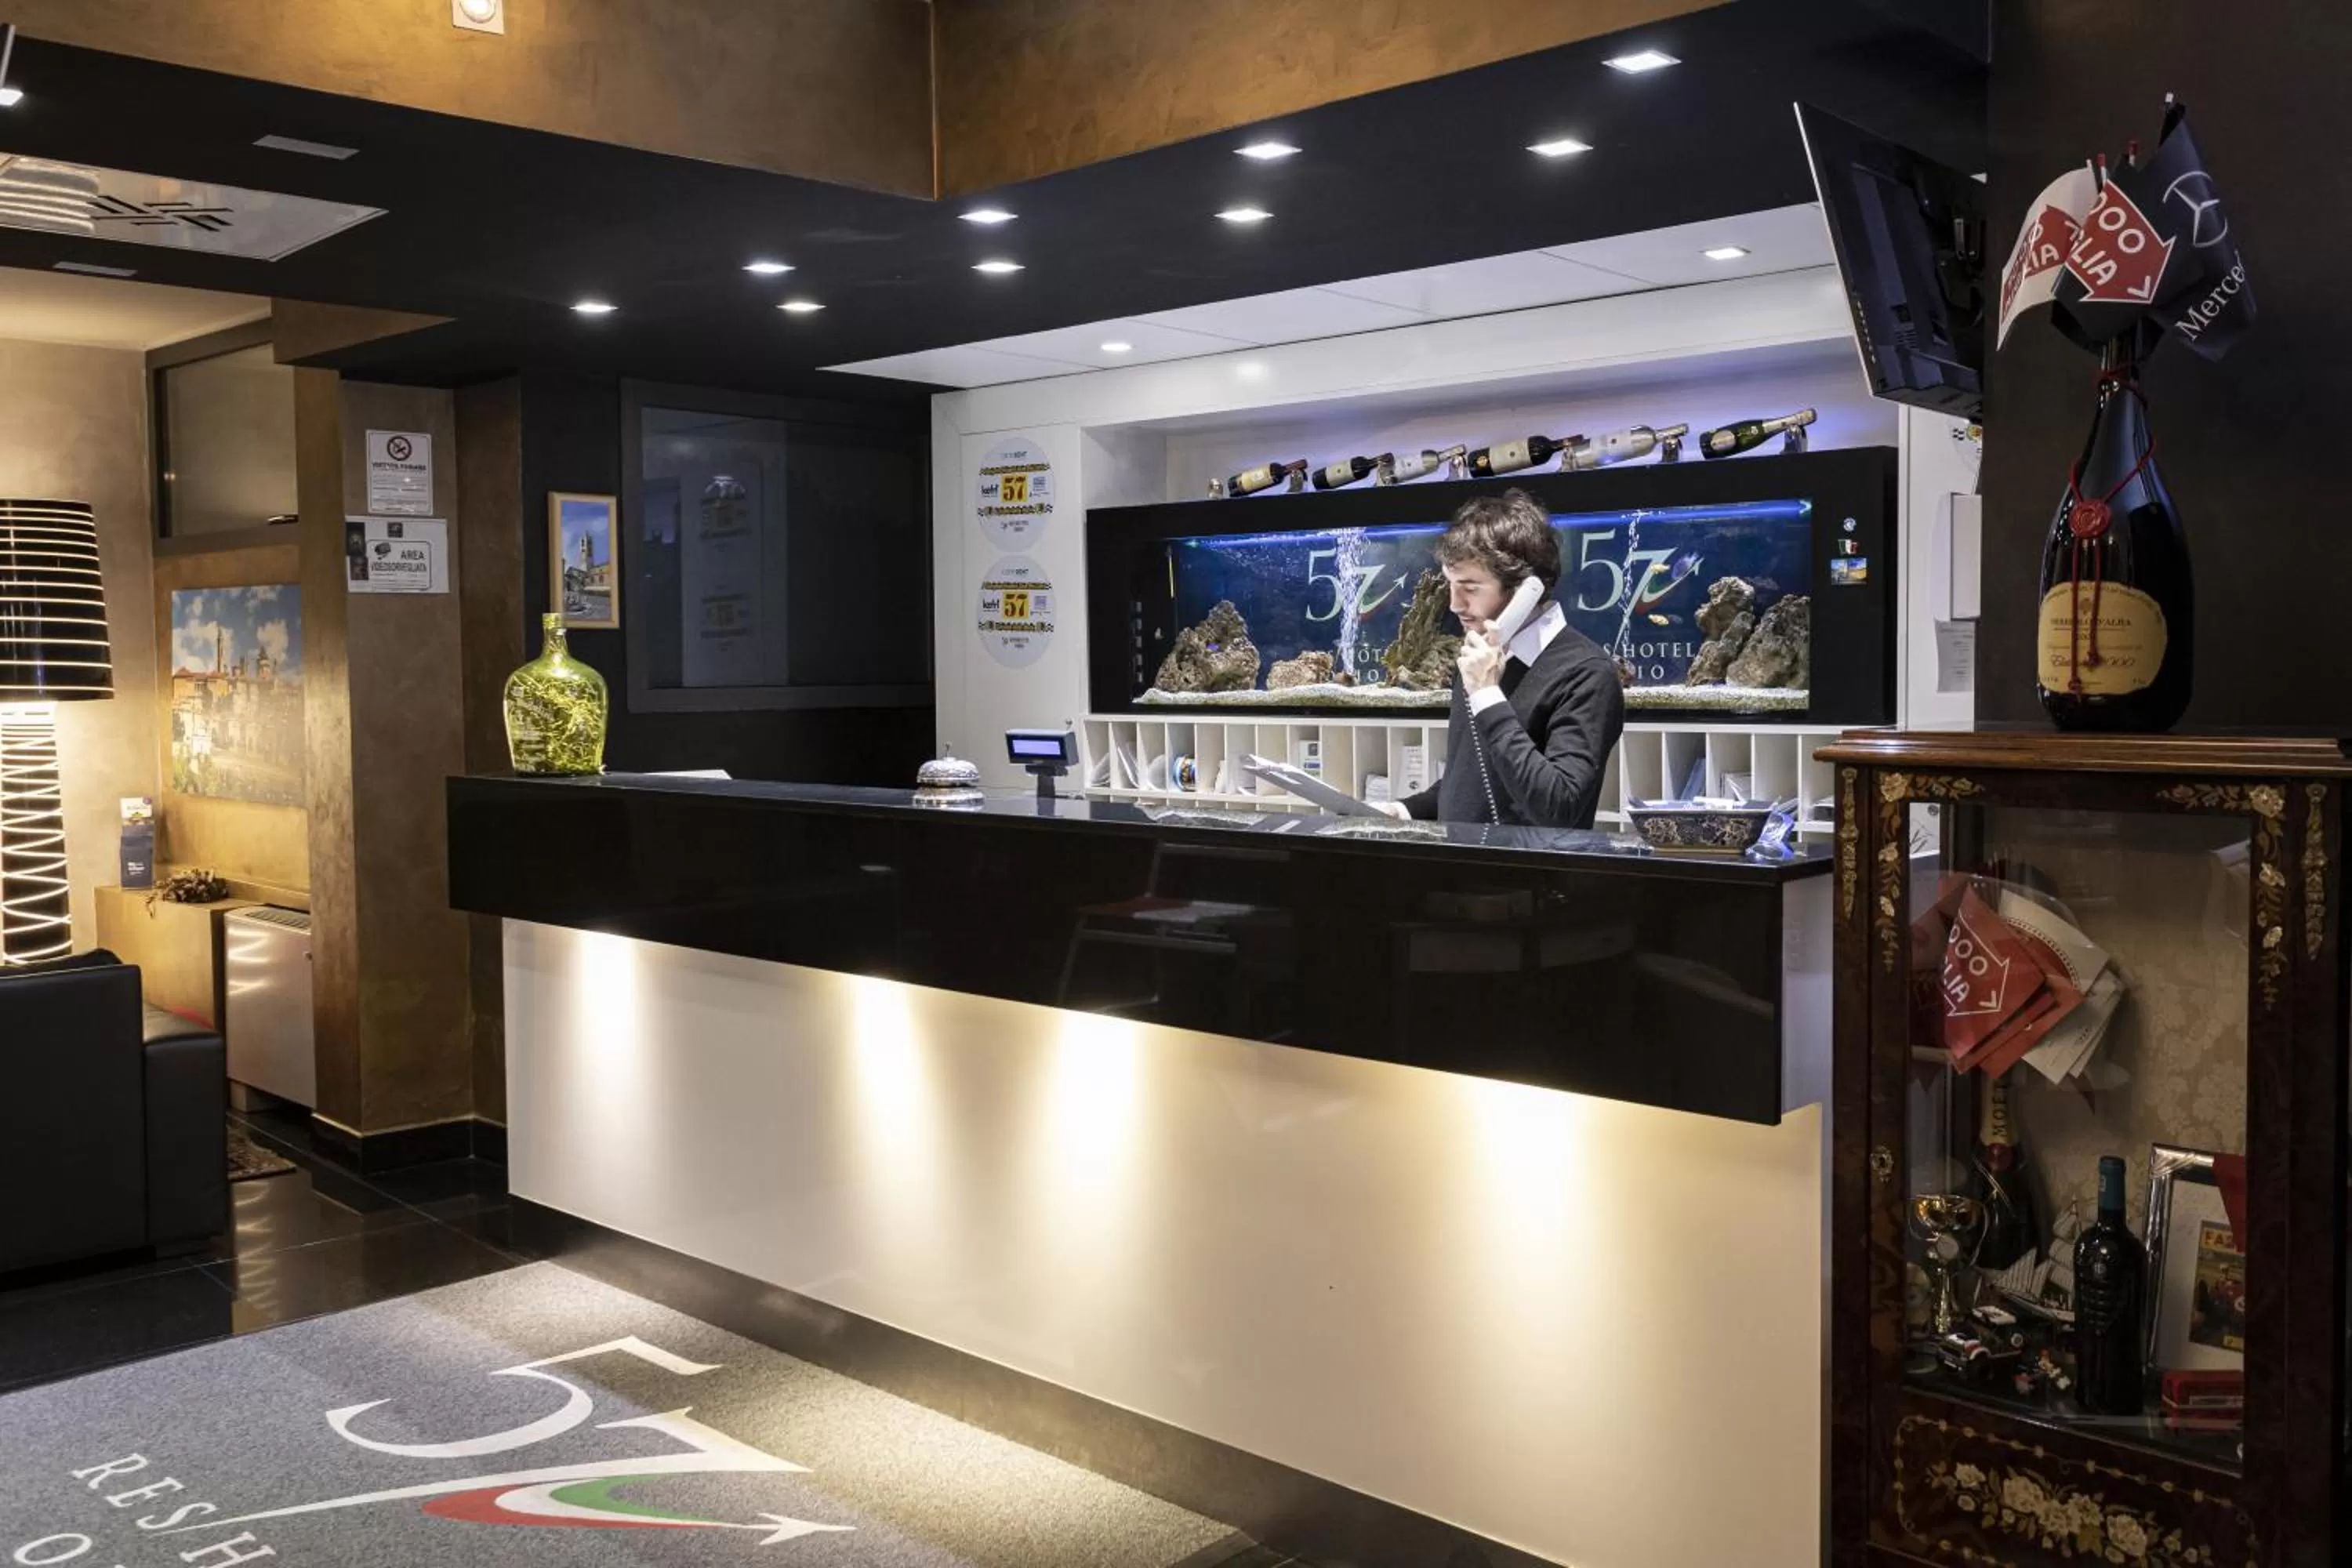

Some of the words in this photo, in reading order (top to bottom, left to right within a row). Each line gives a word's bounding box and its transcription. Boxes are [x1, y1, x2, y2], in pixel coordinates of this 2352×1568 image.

[1004, 477, 1026, 501] 57
[401, 550, 424, 560] AREA
[1577, 528, 1678, 653] 57
[1004, 593, 1028, 617] 57
[1624, 643, 1694, 658] HOTEL
